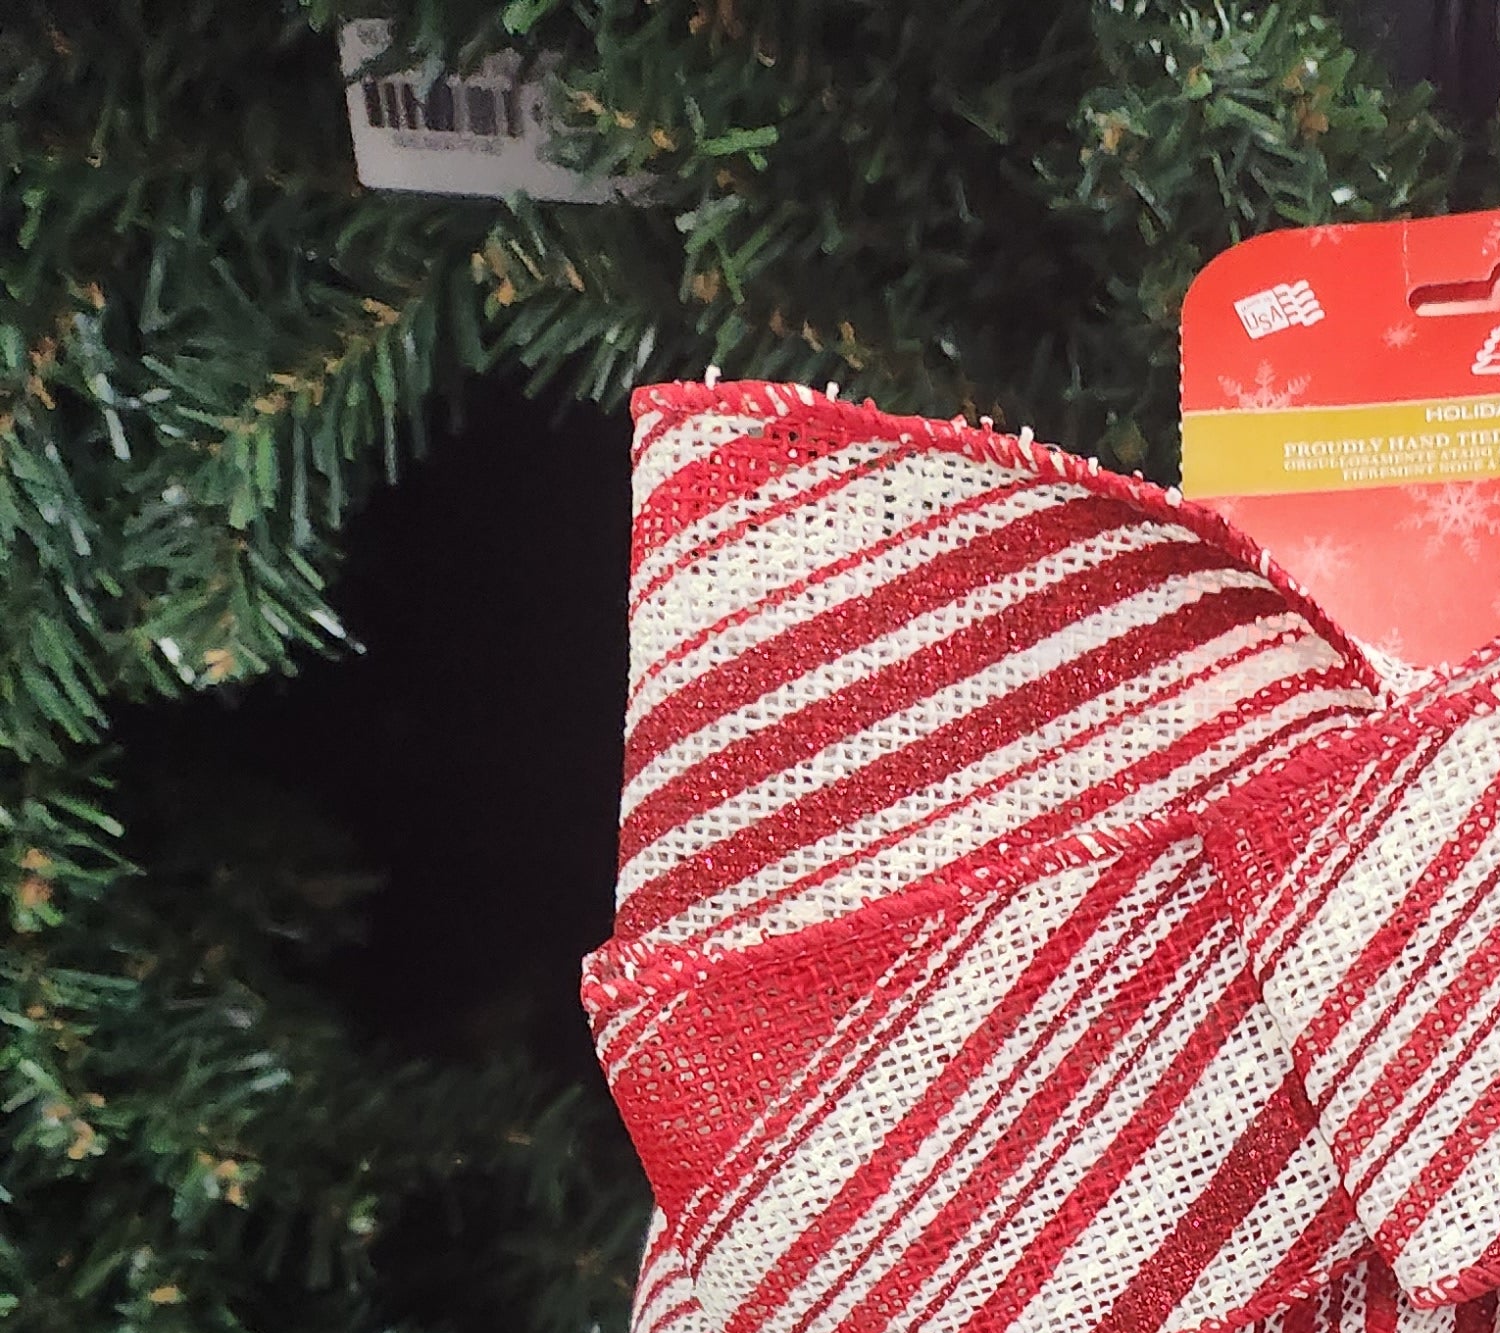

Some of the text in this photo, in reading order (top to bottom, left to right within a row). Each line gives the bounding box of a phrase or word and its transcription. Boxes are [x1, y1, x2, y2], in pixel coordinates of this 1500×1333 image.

[1243, 305, 1283, 331] USA
[1284, 437, 1383, 458] PROUDLY
[1388, 433, 1450, 452] HAND
